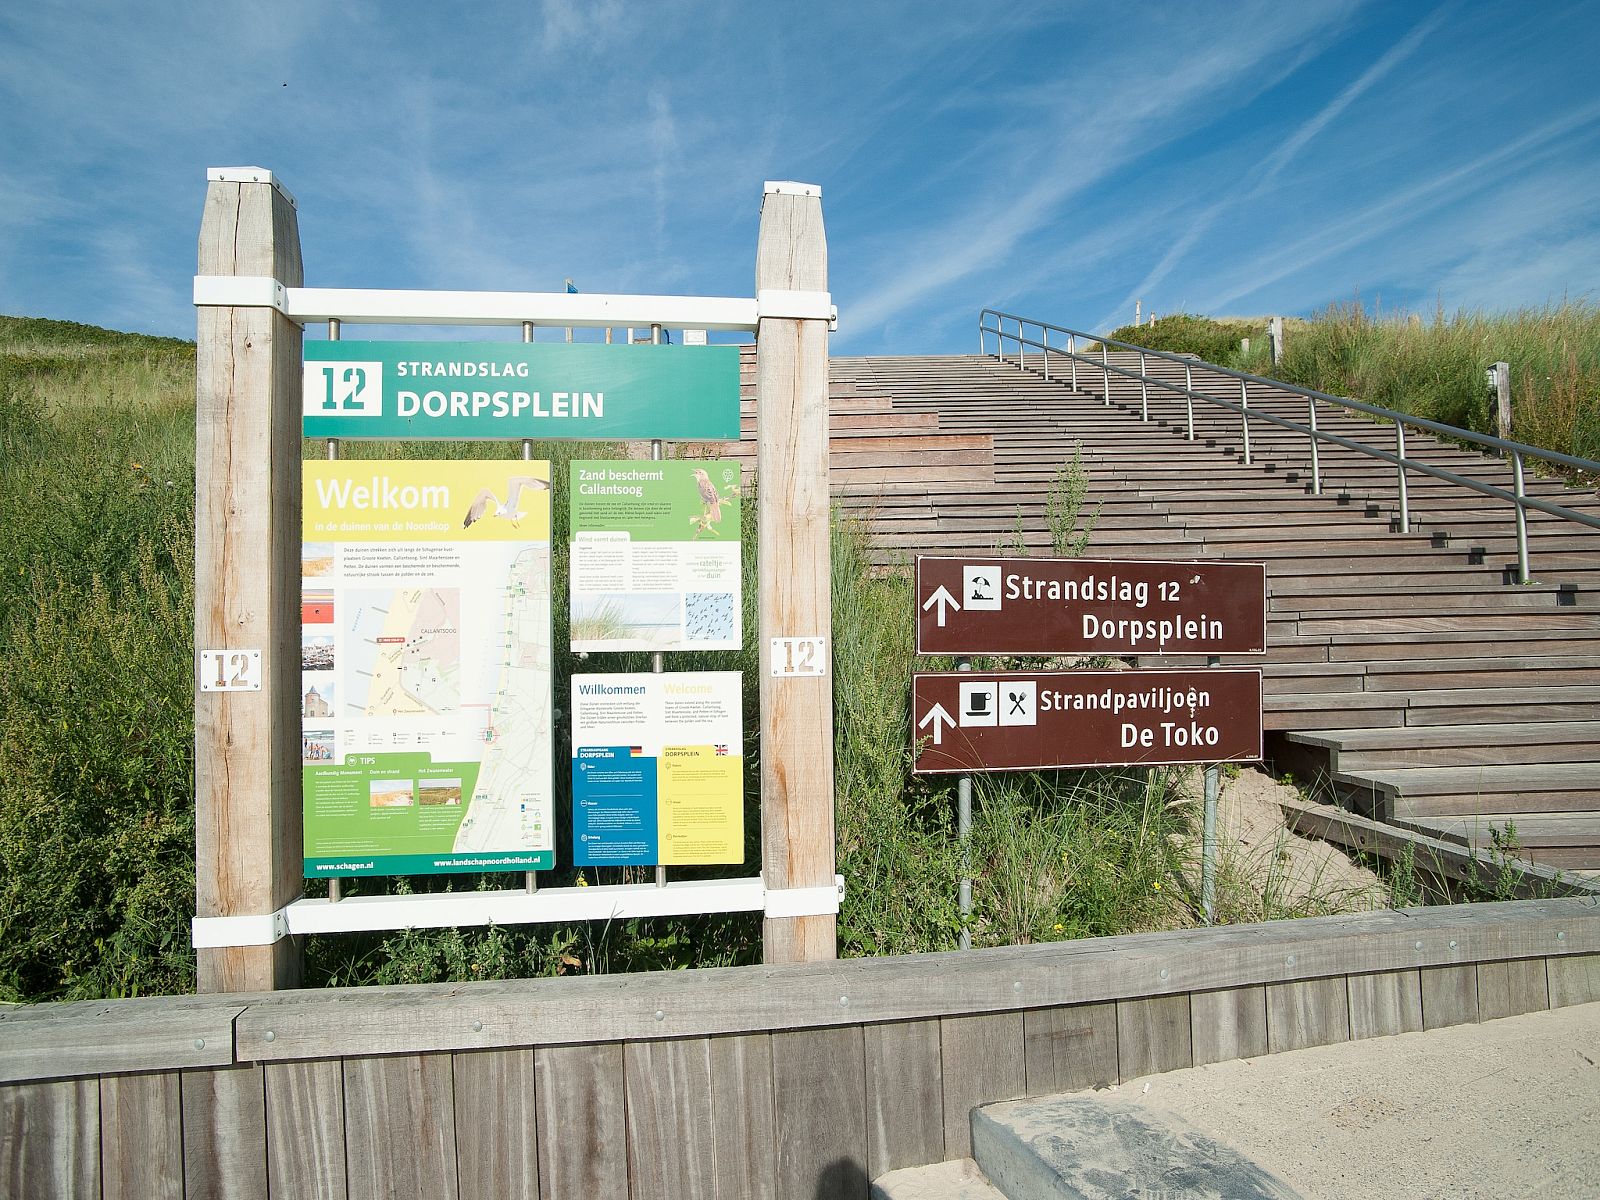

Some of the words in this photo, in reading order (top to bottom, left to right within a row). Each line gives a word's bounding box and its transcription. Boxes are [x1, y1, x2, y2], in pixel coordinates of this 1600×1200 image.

[397, 361, 529, 378] STRANDSLAG
[321, 366, 366, 410] 12
[397, 390, 604, 418] DORPSPLEIN
[579, 469, 606, 481] Zand
[608, 468, 664, 481] beschermt
[315, 476, 450, 509] Welkom
[579, 483, 643, 497] Callantsoog
[315, 522, 323, 532] in
[326, 521, 338, 532] de
[341, 521, 372, 532] duinen
[374, 523, 390, 532] van
[393, 521, 404, 531] de
[406, 521, 449, 533] Noordkop
[1005, 573, 1149, 607] Strandslag
[1157, 581, 1181, 602] 12
[1082, 614, 1223, 645] Dorpsplein
[784, 641, 815, 673] 12
[215, 654, 249, 687] 12
[579, 684, 646, 696] Willkommen
[664, 683, 713, 695] Welcome
[1040, 687, 1210, 714] Strandpaviljoen
[1121, 723, 1153, 748] De
[1160, 722, 1219, 747] Toko
[360, 757, 376, 765] TIPS
[316, 861, 374, 871] www.schagen.nl
[433, 856, 541, 867] www.landschapnoordholland.nl
